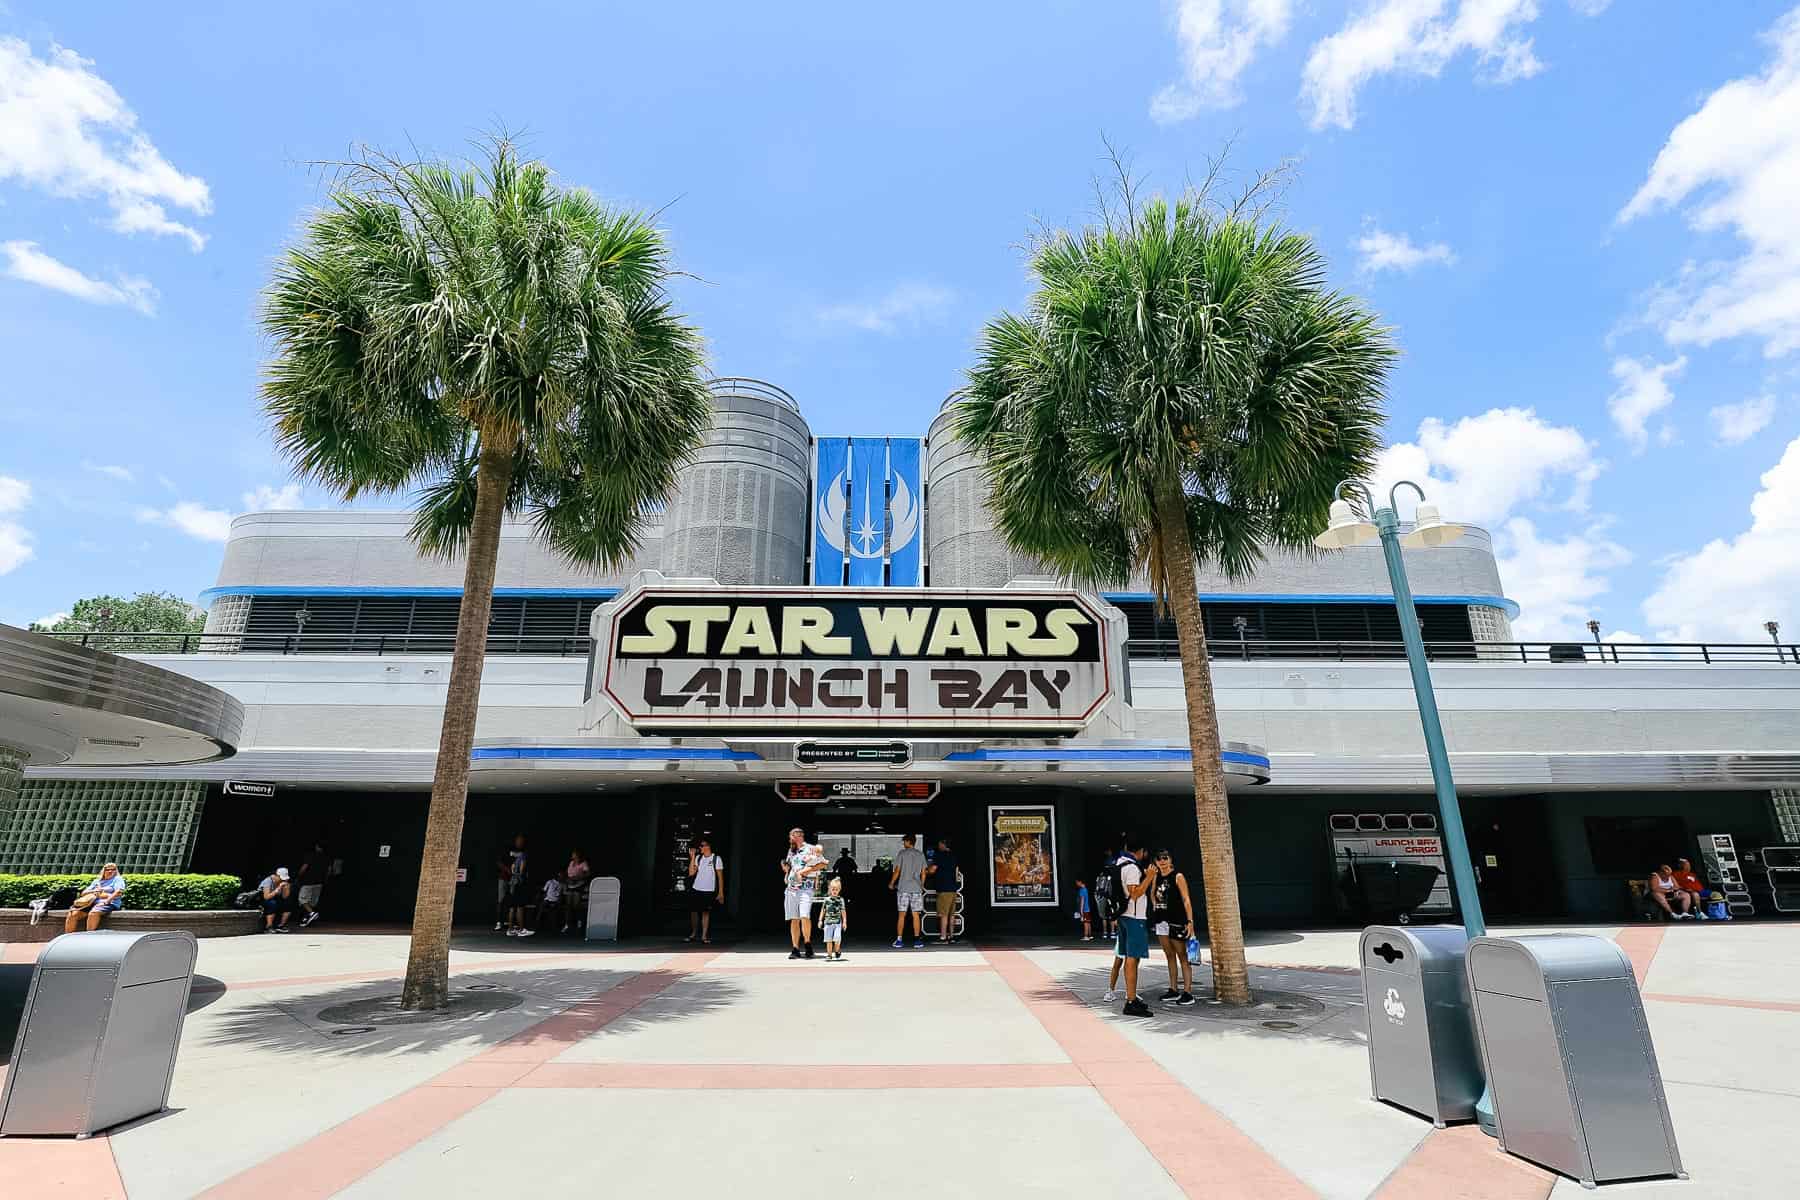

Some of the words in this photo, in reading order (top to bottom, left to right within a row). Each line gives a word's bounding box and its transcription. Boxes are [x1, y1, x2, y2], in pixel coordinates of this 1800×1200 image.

[620, 605, 852, 655] STAR
[858, 606, 1095, 657] WARS
[642, 667, 909, 708] LAUNCH
[931, 669, 1072, 710] BAY
[234, 784, 267, 793] women
[832, 783, 886, 791] CHARACTER
